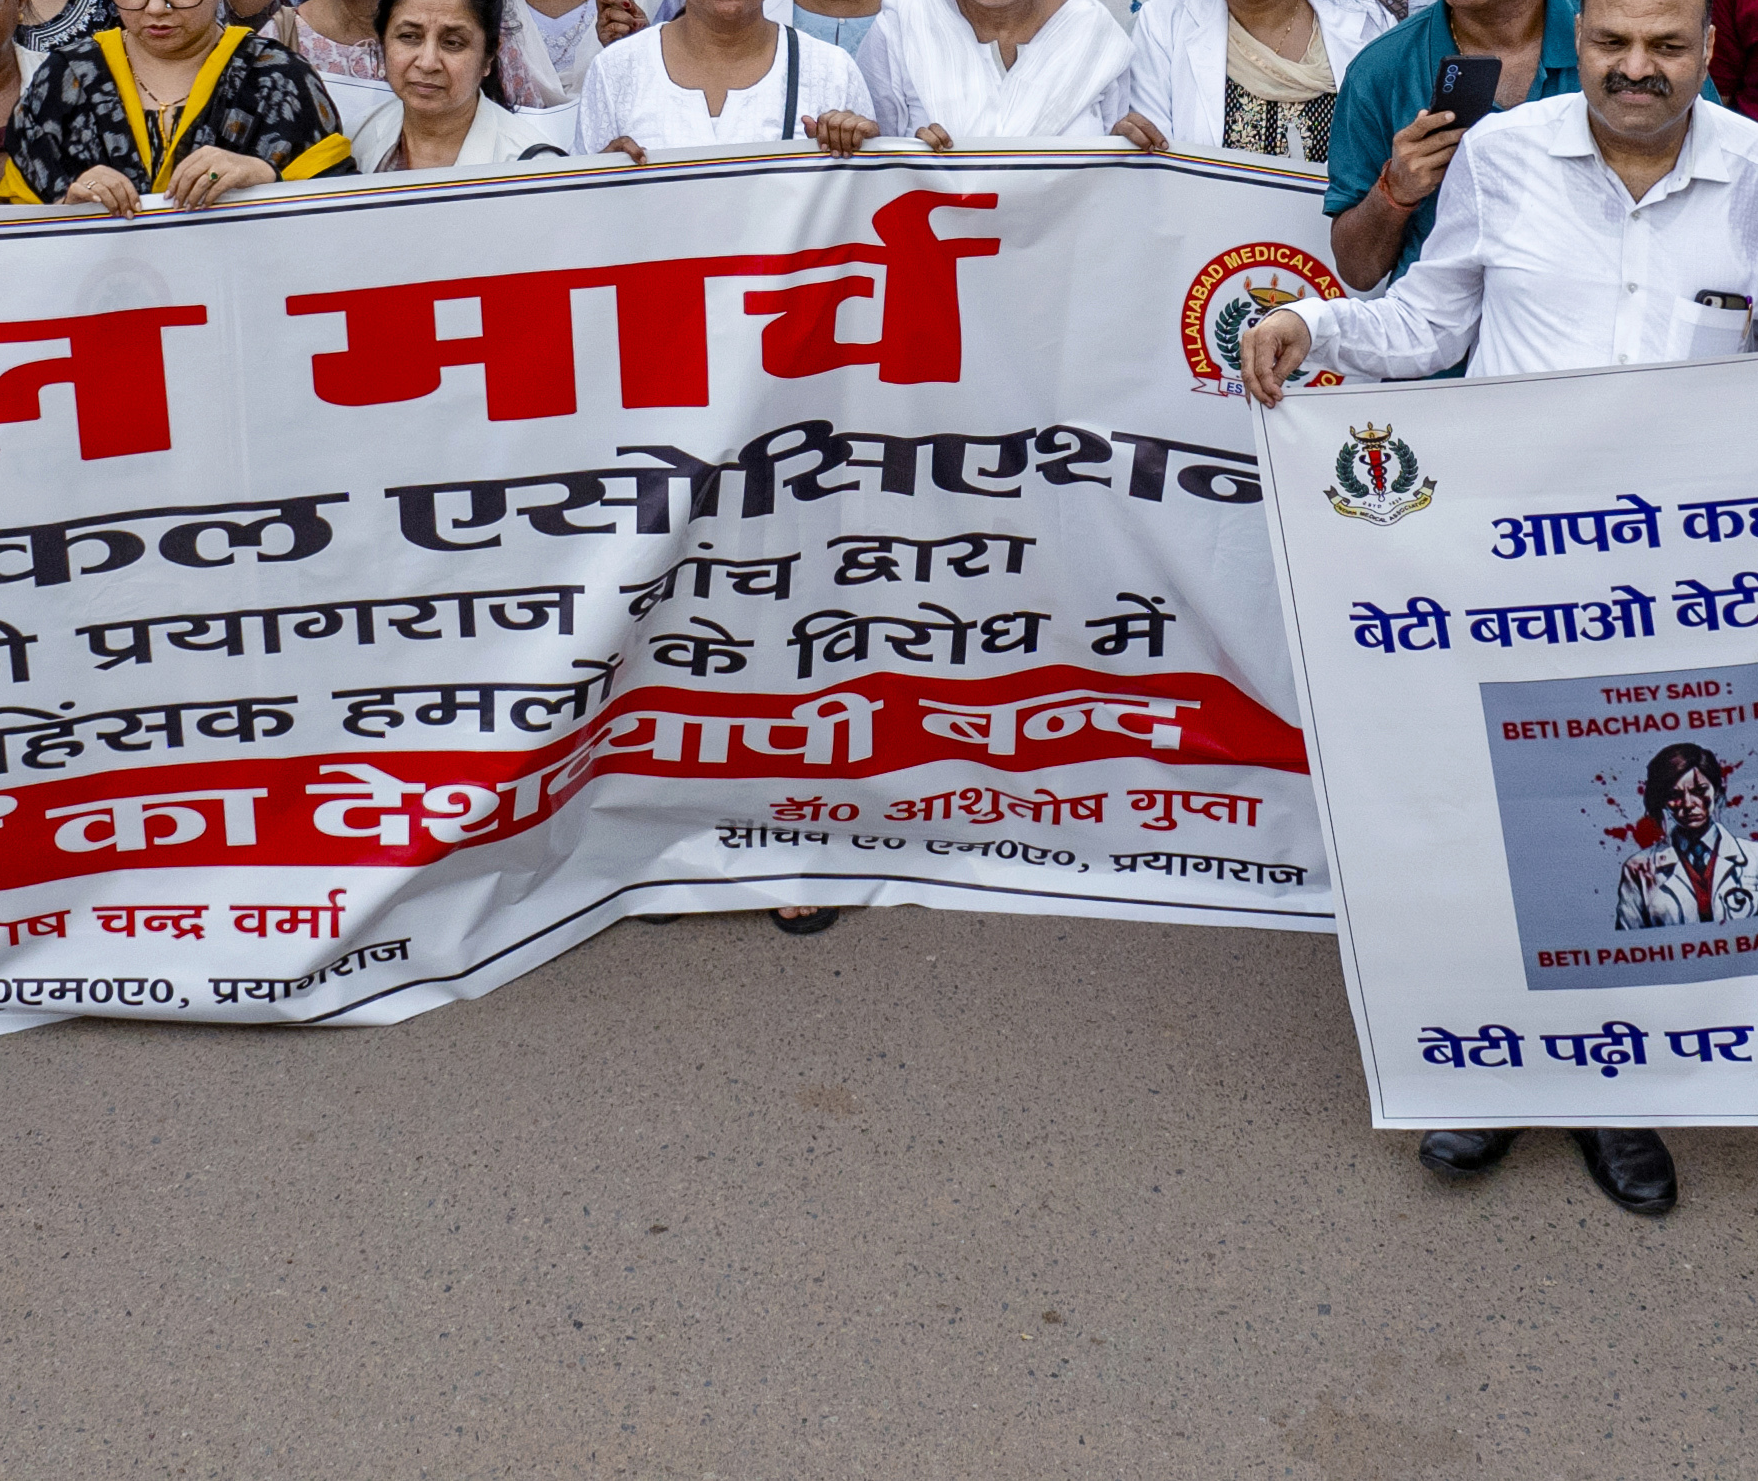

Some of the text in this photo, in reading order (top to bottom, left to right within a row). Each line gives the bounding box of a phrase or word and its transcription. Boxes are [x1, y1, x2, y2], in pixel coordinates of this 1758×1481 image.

[285, 189, 1001, 422] मार्च
[77, 584, 584, 672] प्रयागराज
[826, 531, 1036, 586] द्वारा
[333, 655, 623, 738] हमलों
[651, 616, 753, 678] के
[788, 602, 1051, 679] विरोध
[1085, 591, 1176, 658] में
[54, 785, 268, 855] का
[918, 690, 1202, 755] बन्द
[884, 788, 1108, 825] आशुतोष
[1127, 790, 1263, 831] गुप्ता
[92, 906, 209, 940] चन्द्र
[230, 889, 346, 938] वर्मा
